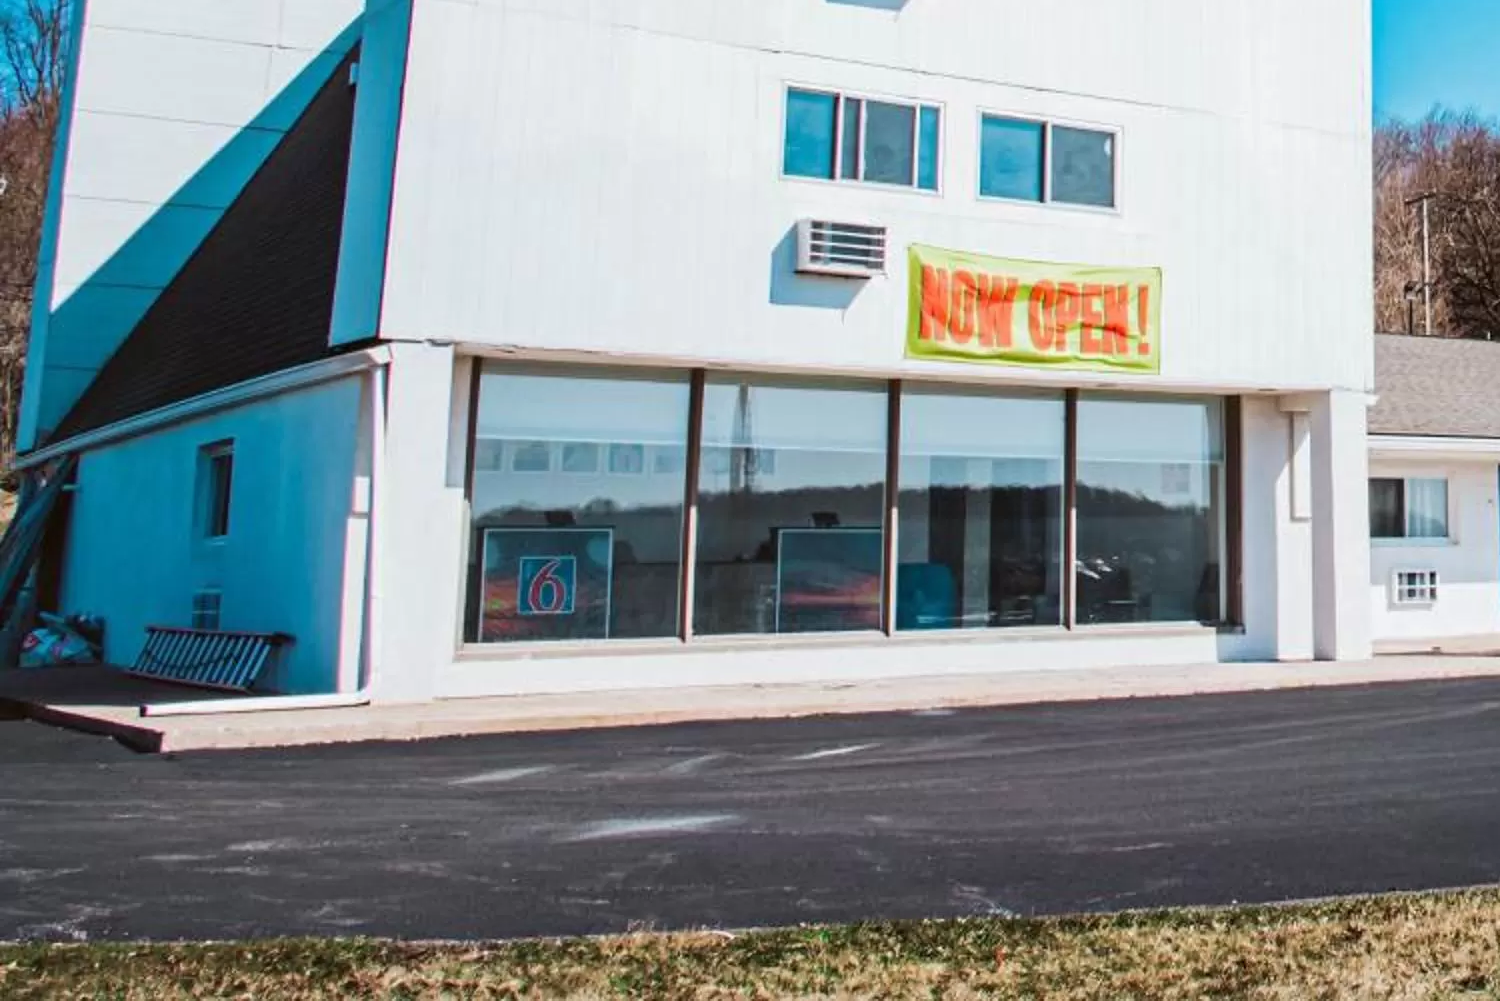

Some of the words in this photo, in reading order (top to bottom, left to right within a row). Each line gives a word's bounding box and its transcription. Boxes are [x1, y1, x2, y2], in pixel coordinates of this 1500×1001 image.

[920, 264, 1018, 349] NOW
[1028, 278, 1150, 355] OPEN!
[528, 559, 567, 612] 6
